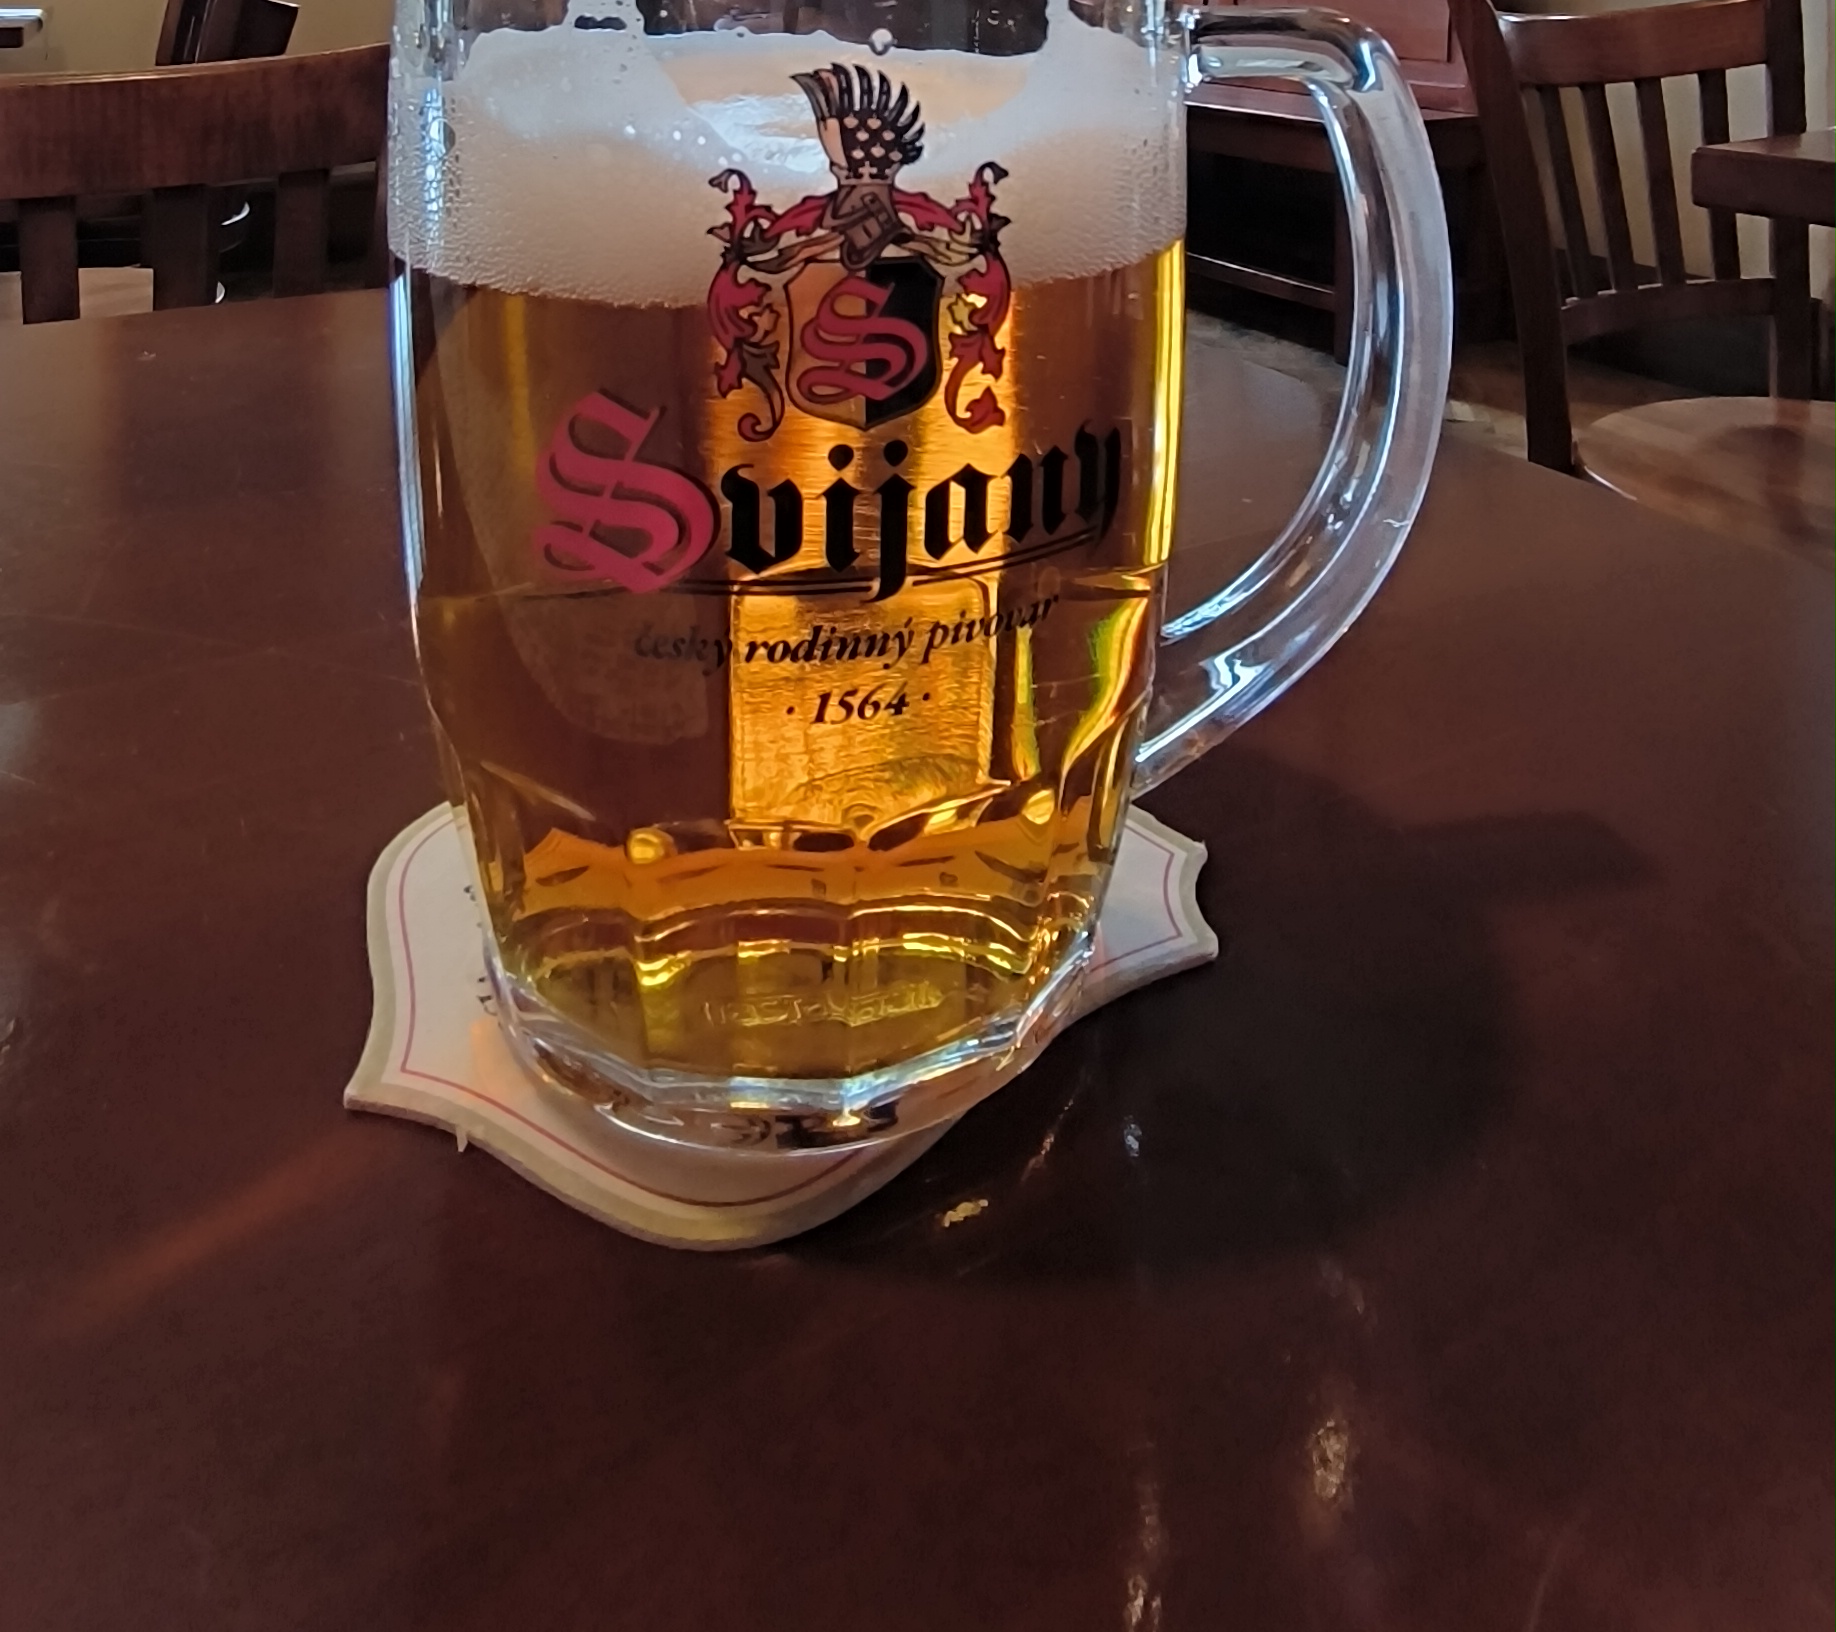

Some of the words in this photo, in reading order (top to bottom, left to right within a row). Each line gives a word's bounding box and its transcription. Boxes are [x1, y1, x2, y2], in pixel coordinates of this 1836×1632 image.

[797, 272, 927, 404] S
[533, 388, 1121, 602] Svijany
[634, 622, 732, 676] český
[744, 617, 914, 670] rodinný
[921, 594, 1060, 664] pivovar
